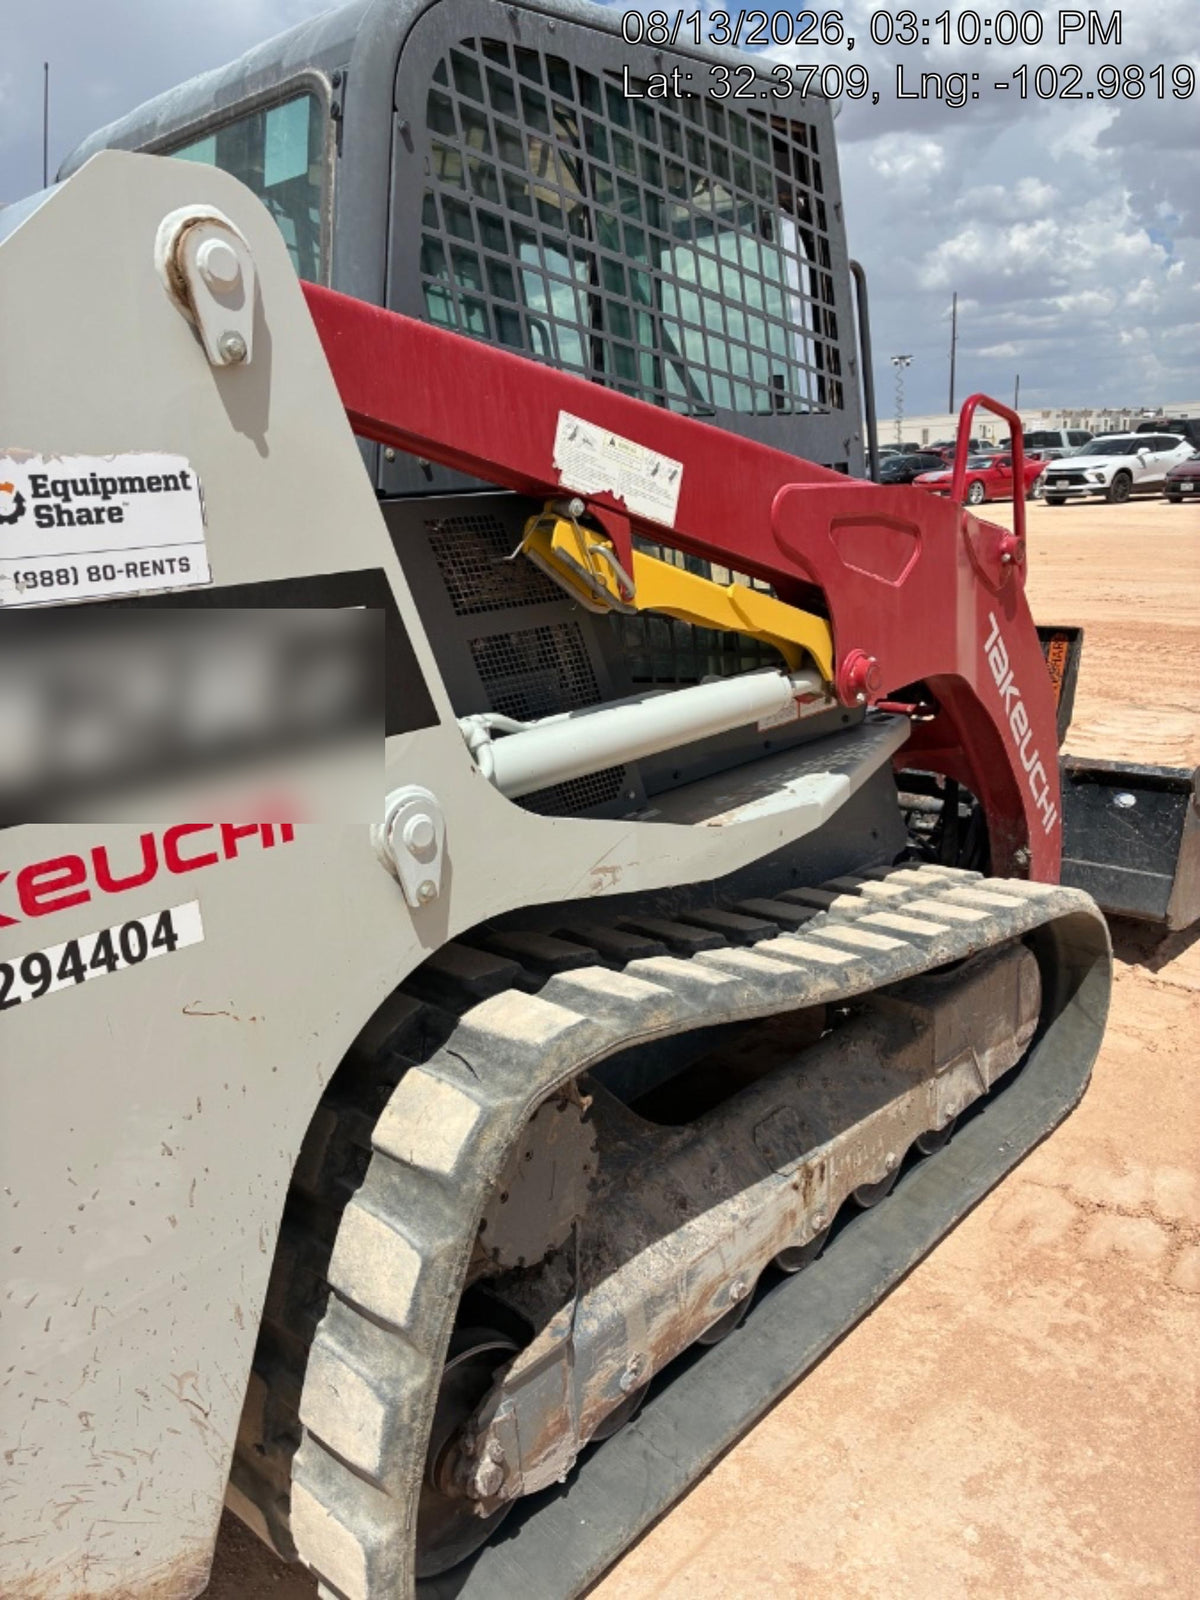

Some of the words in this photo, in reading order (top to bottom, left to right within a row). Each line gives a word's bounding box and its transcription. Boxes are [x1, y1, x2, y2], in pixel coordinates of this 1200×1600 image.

[28, 470, 193, 502] Equipment
[13, 565, 79, 589] (888)
[86, 556, 191, 583] 80-RENTS
[0, 909, 179, 1011] 294404
